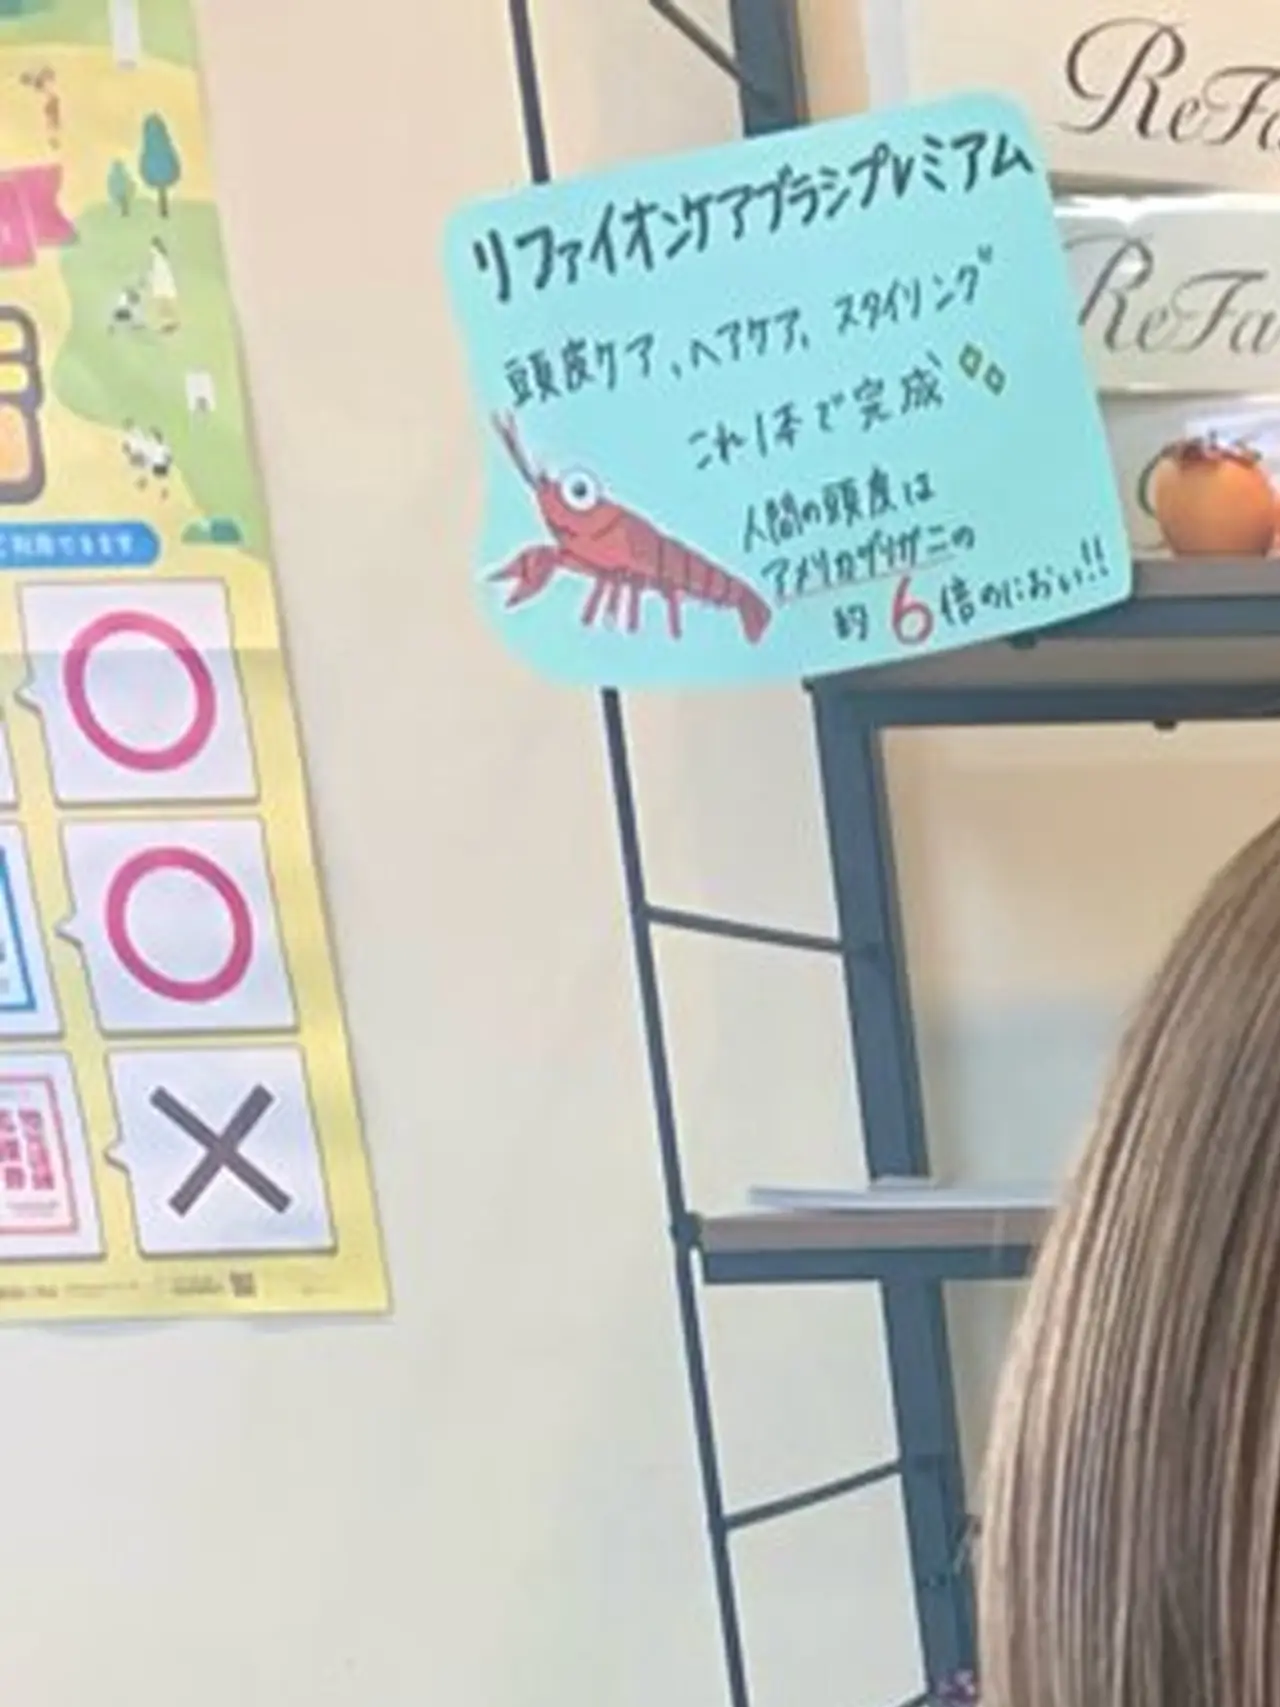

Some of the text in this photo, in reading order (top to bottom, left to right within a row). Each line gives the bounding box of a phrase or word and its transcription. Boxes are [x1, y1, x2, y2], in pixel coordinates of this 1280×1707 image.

[472, 130, 1034, 303] リファイオンケアブラシプレミアム
